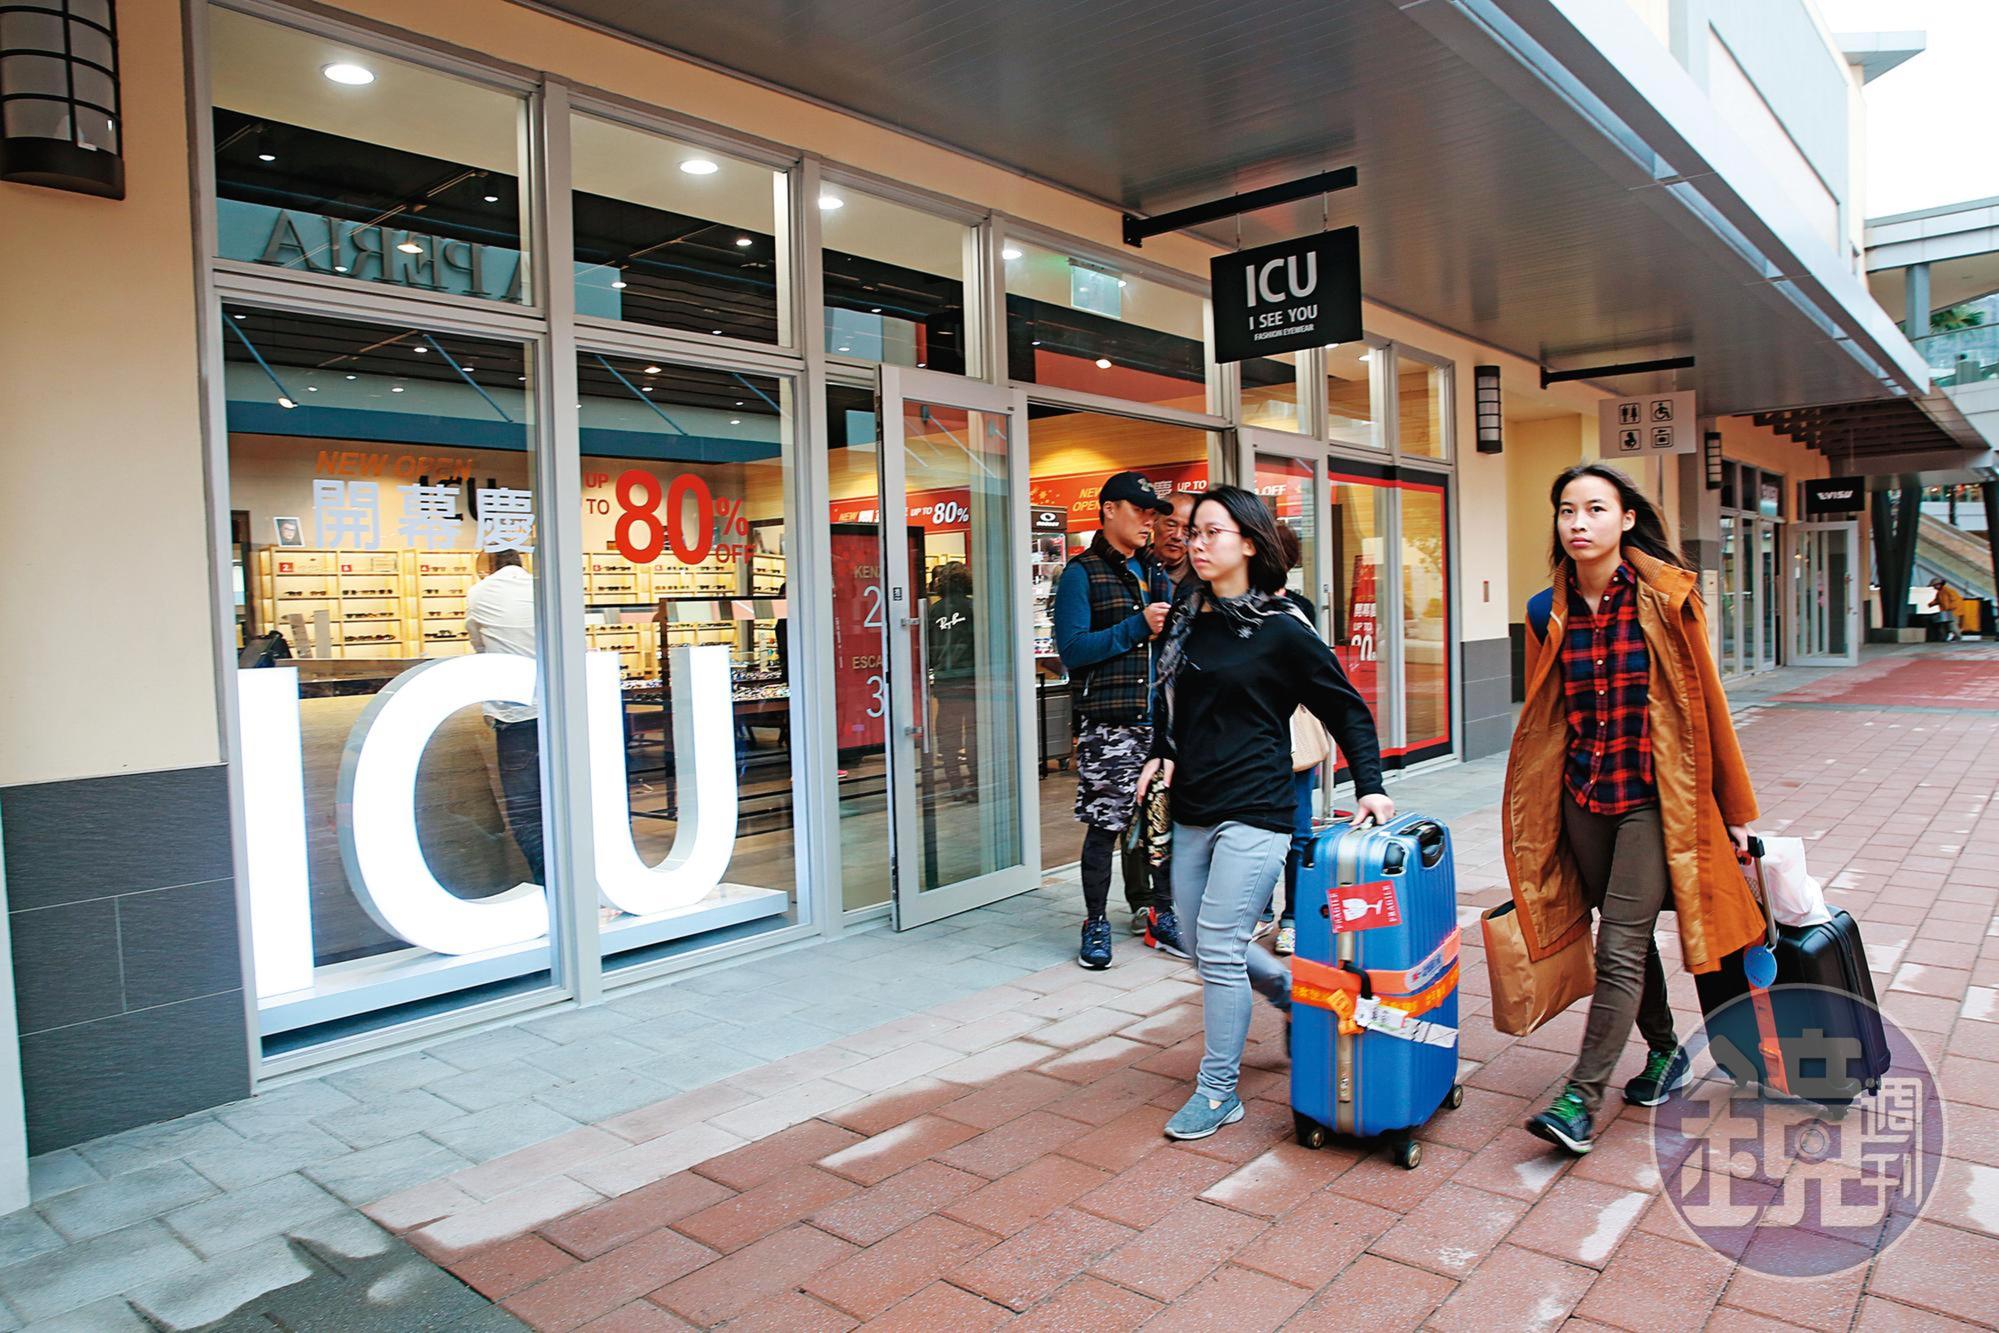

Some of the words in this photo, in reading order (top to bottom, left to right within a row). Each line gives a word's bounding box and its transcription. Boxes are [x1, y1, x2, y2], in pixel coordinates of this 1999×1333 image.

[1245, 251, 1318, 307] ICU
[1249, 316, 1254, 330] I
[1259, 311, 1283, 328] SEE
[1288, 304, 1318, 322] YOU
[1254, 329, 1283, 341] FASHION
[1283, 324, 1314, 336] EYEWEAR
[315, 451, 389, 476] NEW
[393, 455, 473, 480] OPEN
[585, 473, 609, 488] UP
[1177, 482, 1191, 492] UP
[1193, 480, 1207, 490] TO
[1262, 485, 1287, 496] OFF
[312, 479, 535, 554] 開幕慶
[586, 499, 610, 515] TO
[910, 507, 922, 516] UP
[922, 506, 933, 515] TO
[932, 501, 969, 524] 80%
[715, 543, 757, 565] OFF
[864, 585, 882, 627] 2
[866, 675, 884, 717] 3
[238, 645, 738, 997] ICU
